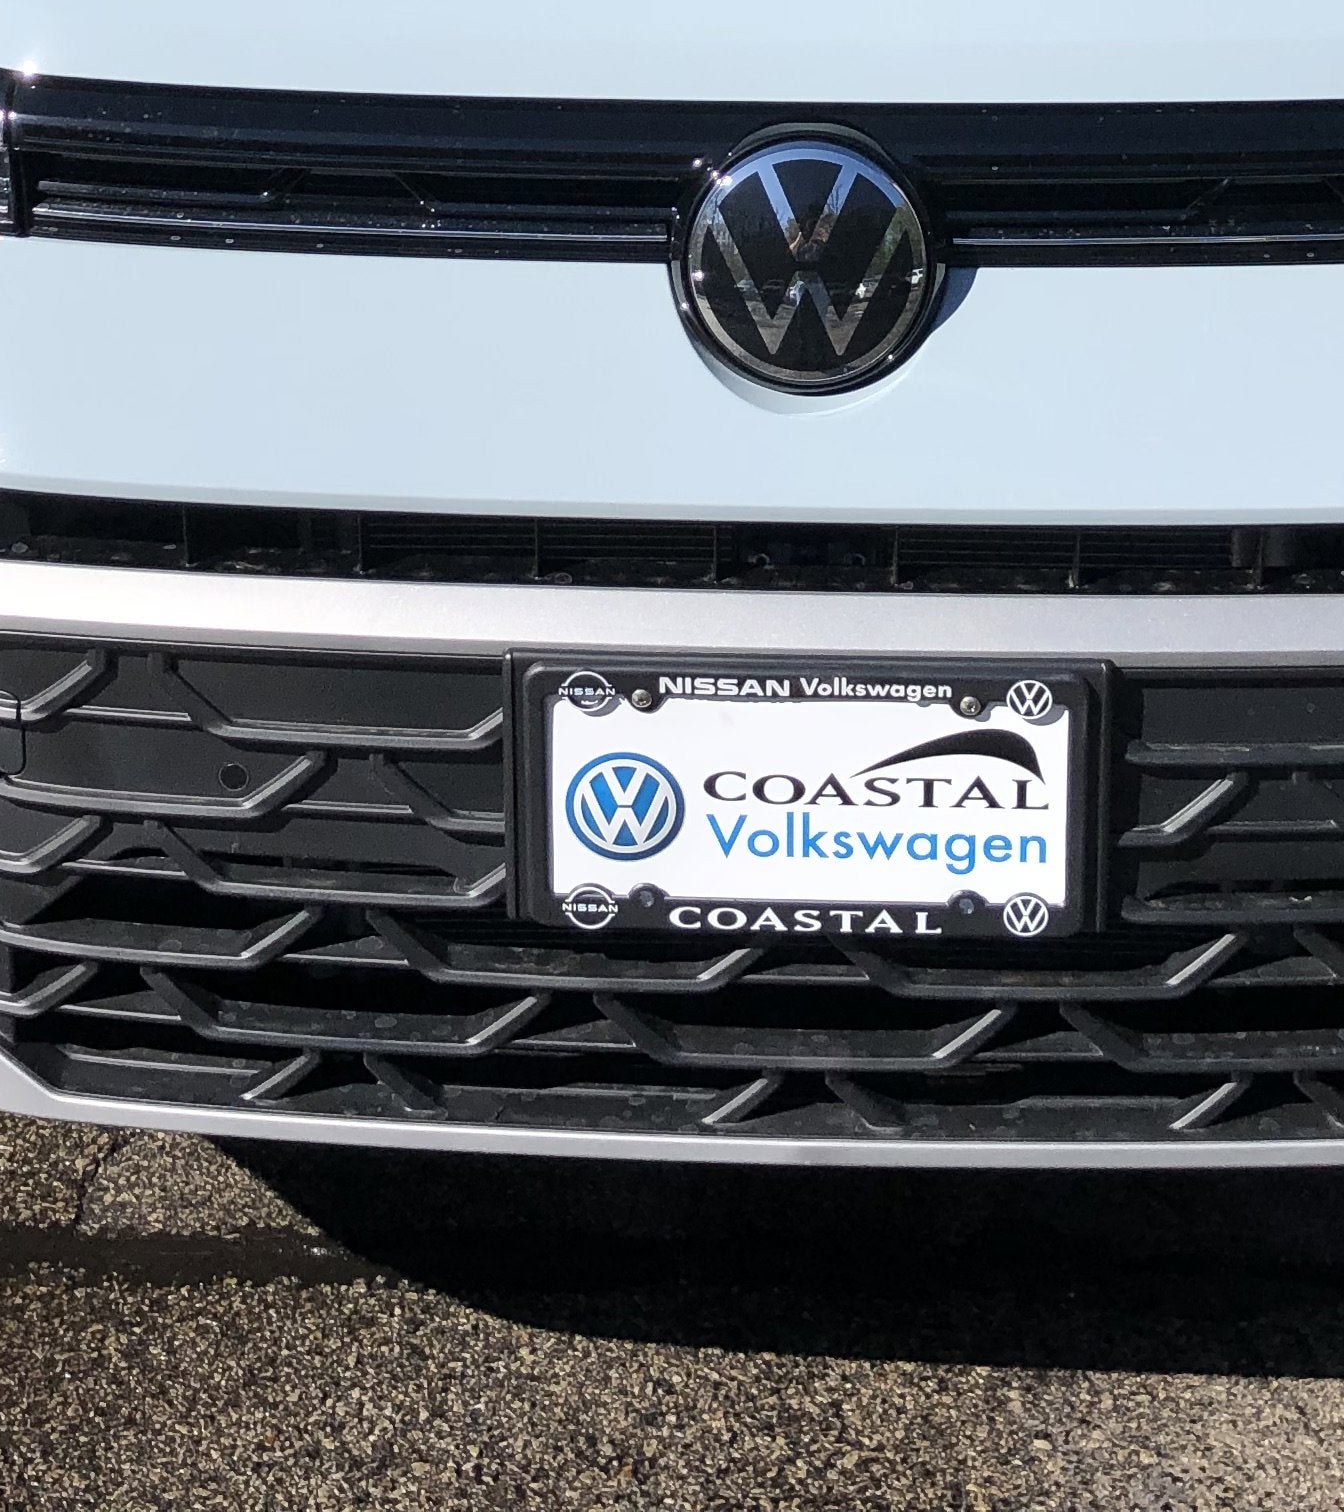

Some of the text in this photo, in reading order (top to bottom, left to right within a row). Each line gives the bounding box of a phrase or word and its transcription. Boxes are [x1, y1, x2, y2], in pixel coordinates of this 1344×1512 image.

[558, 687, 616, 696] NISSAN
[659, 677, 953, 701] NISSAN Volkswagen
[702, 770, 1050, 811] COASTAL
[706, 811, 1048, 875] Volkswagen
[562, 902, 619, 913] NISSAN
[668, 905, 942, 935] COASTAL
